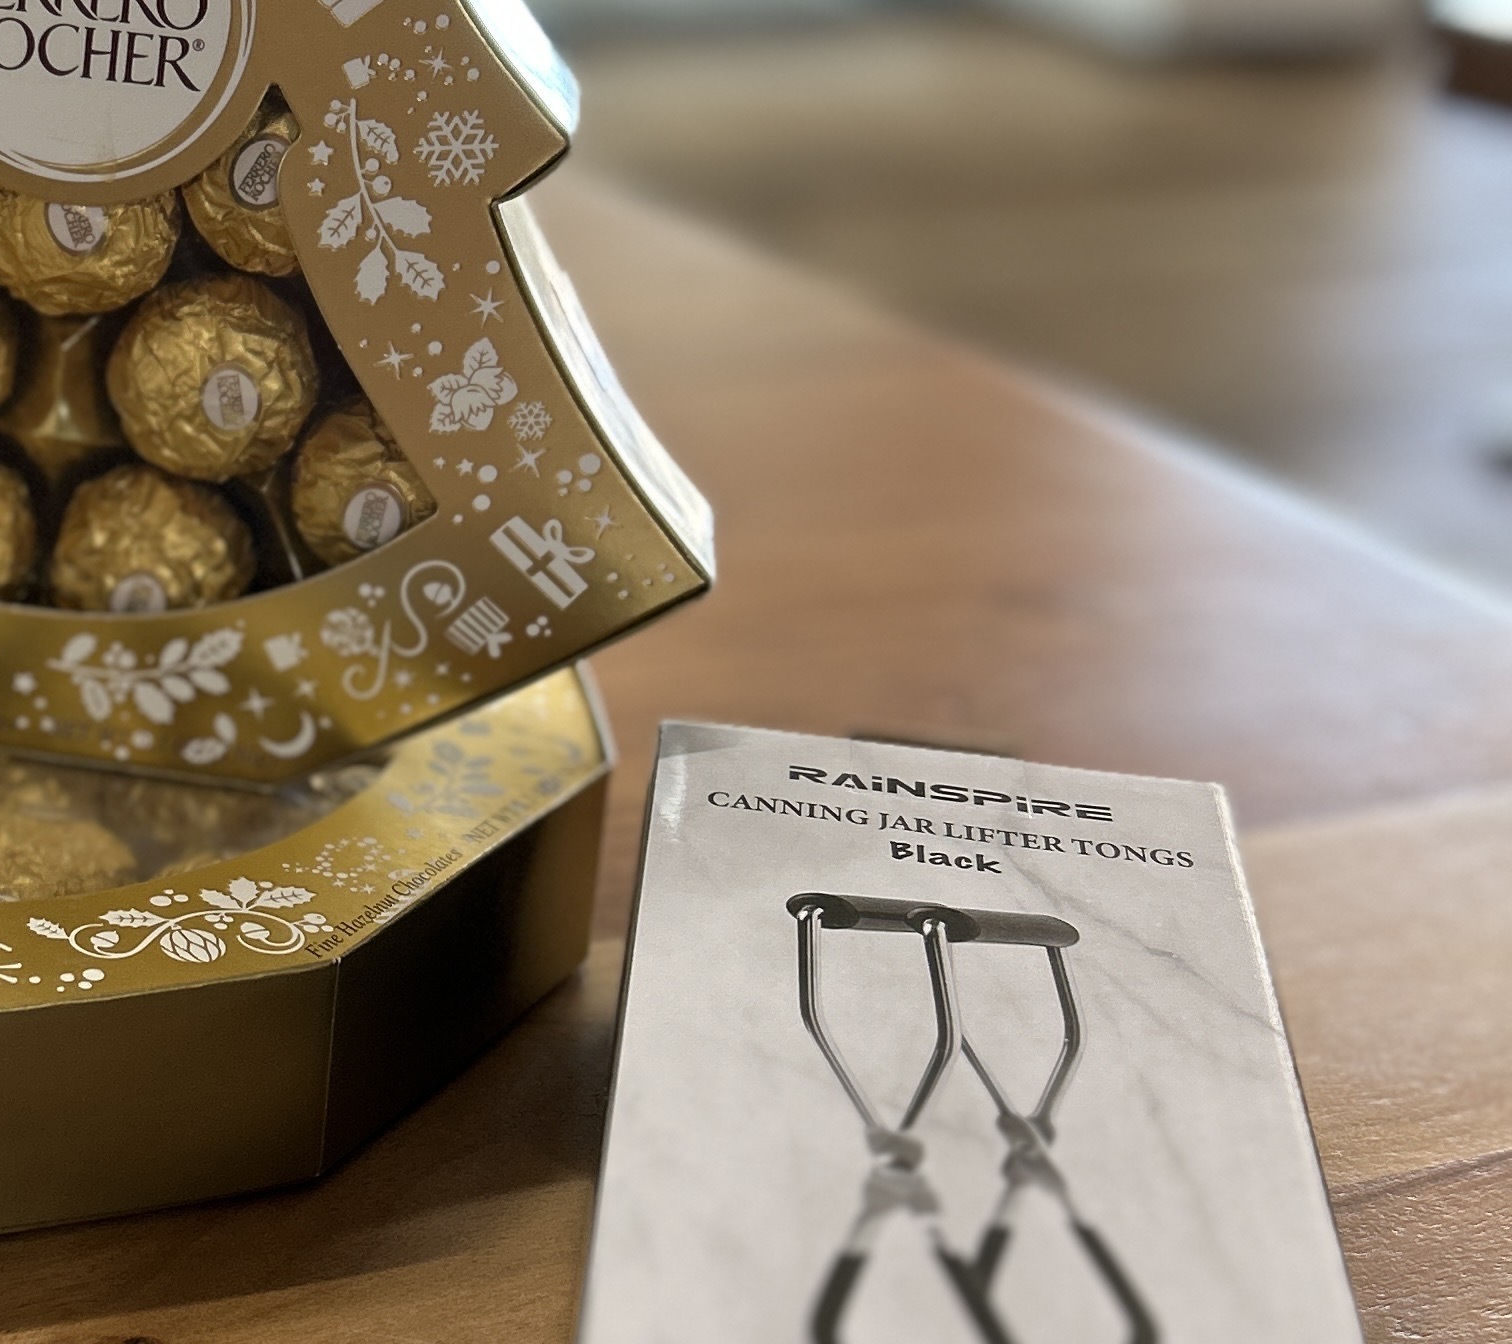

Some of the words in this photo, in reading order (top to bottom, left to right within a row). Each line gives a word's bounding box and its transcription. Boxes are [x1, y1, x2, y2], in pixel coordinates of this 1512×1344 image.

[238, 143, 276, 195] FERRERO
[706, 790, 870, 827] CANNING
[878, 812, 937, 837] JAR
[942, 822, 1062, 854] LIFTER
[1071, 837, 1195, 869] TONGS
[890, 841, 1003, 875] Black
[304, 932, 345, 960] Fine
[334, 893, 400, 938] Hazelnut
[391, 846, 464, 901] Chocolates
